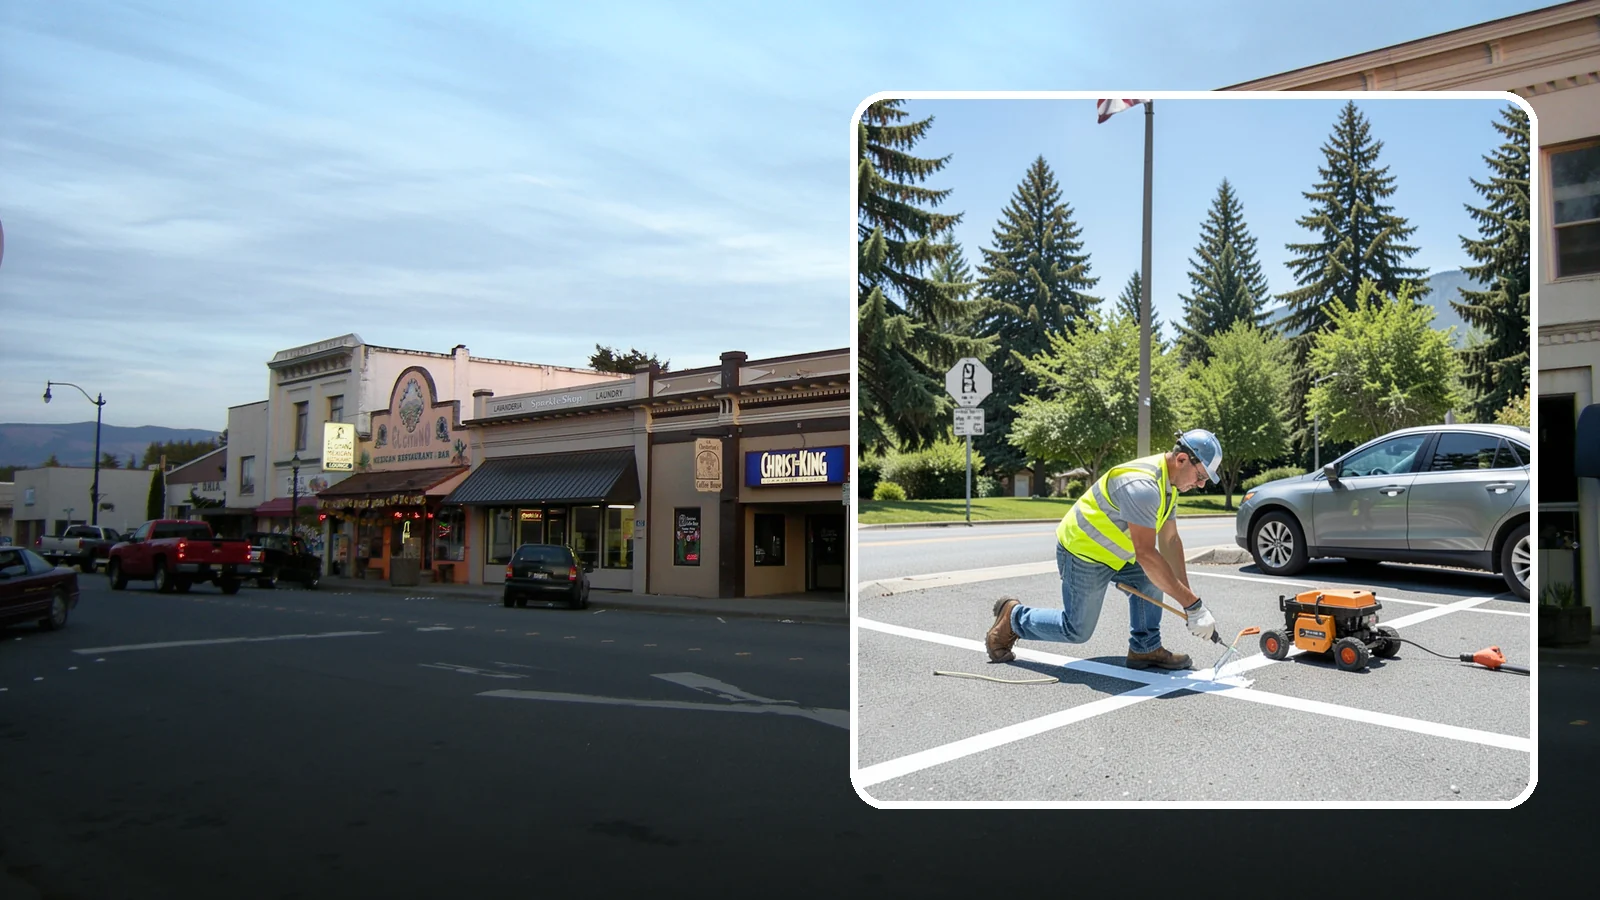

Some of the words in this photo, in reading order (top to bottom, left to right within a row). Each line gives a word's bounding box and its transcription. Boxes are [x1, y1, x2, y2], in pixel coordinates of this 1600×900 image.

[531, 397, 561, 409] Sparkle
[562, 394, 582, 404] Shop
[595, 389, 624, 400] LAUNDRY
[493, 402, 523, 412] LAVANDERIA
[373, 455, 396, 464] MEXICAN
[397, 452, 433, 462] RESTAURANT
[437, 450, 450, 459] BAR
[761, 452, 797, 478] CHRIST
[799, 450, 827, 476] KING
